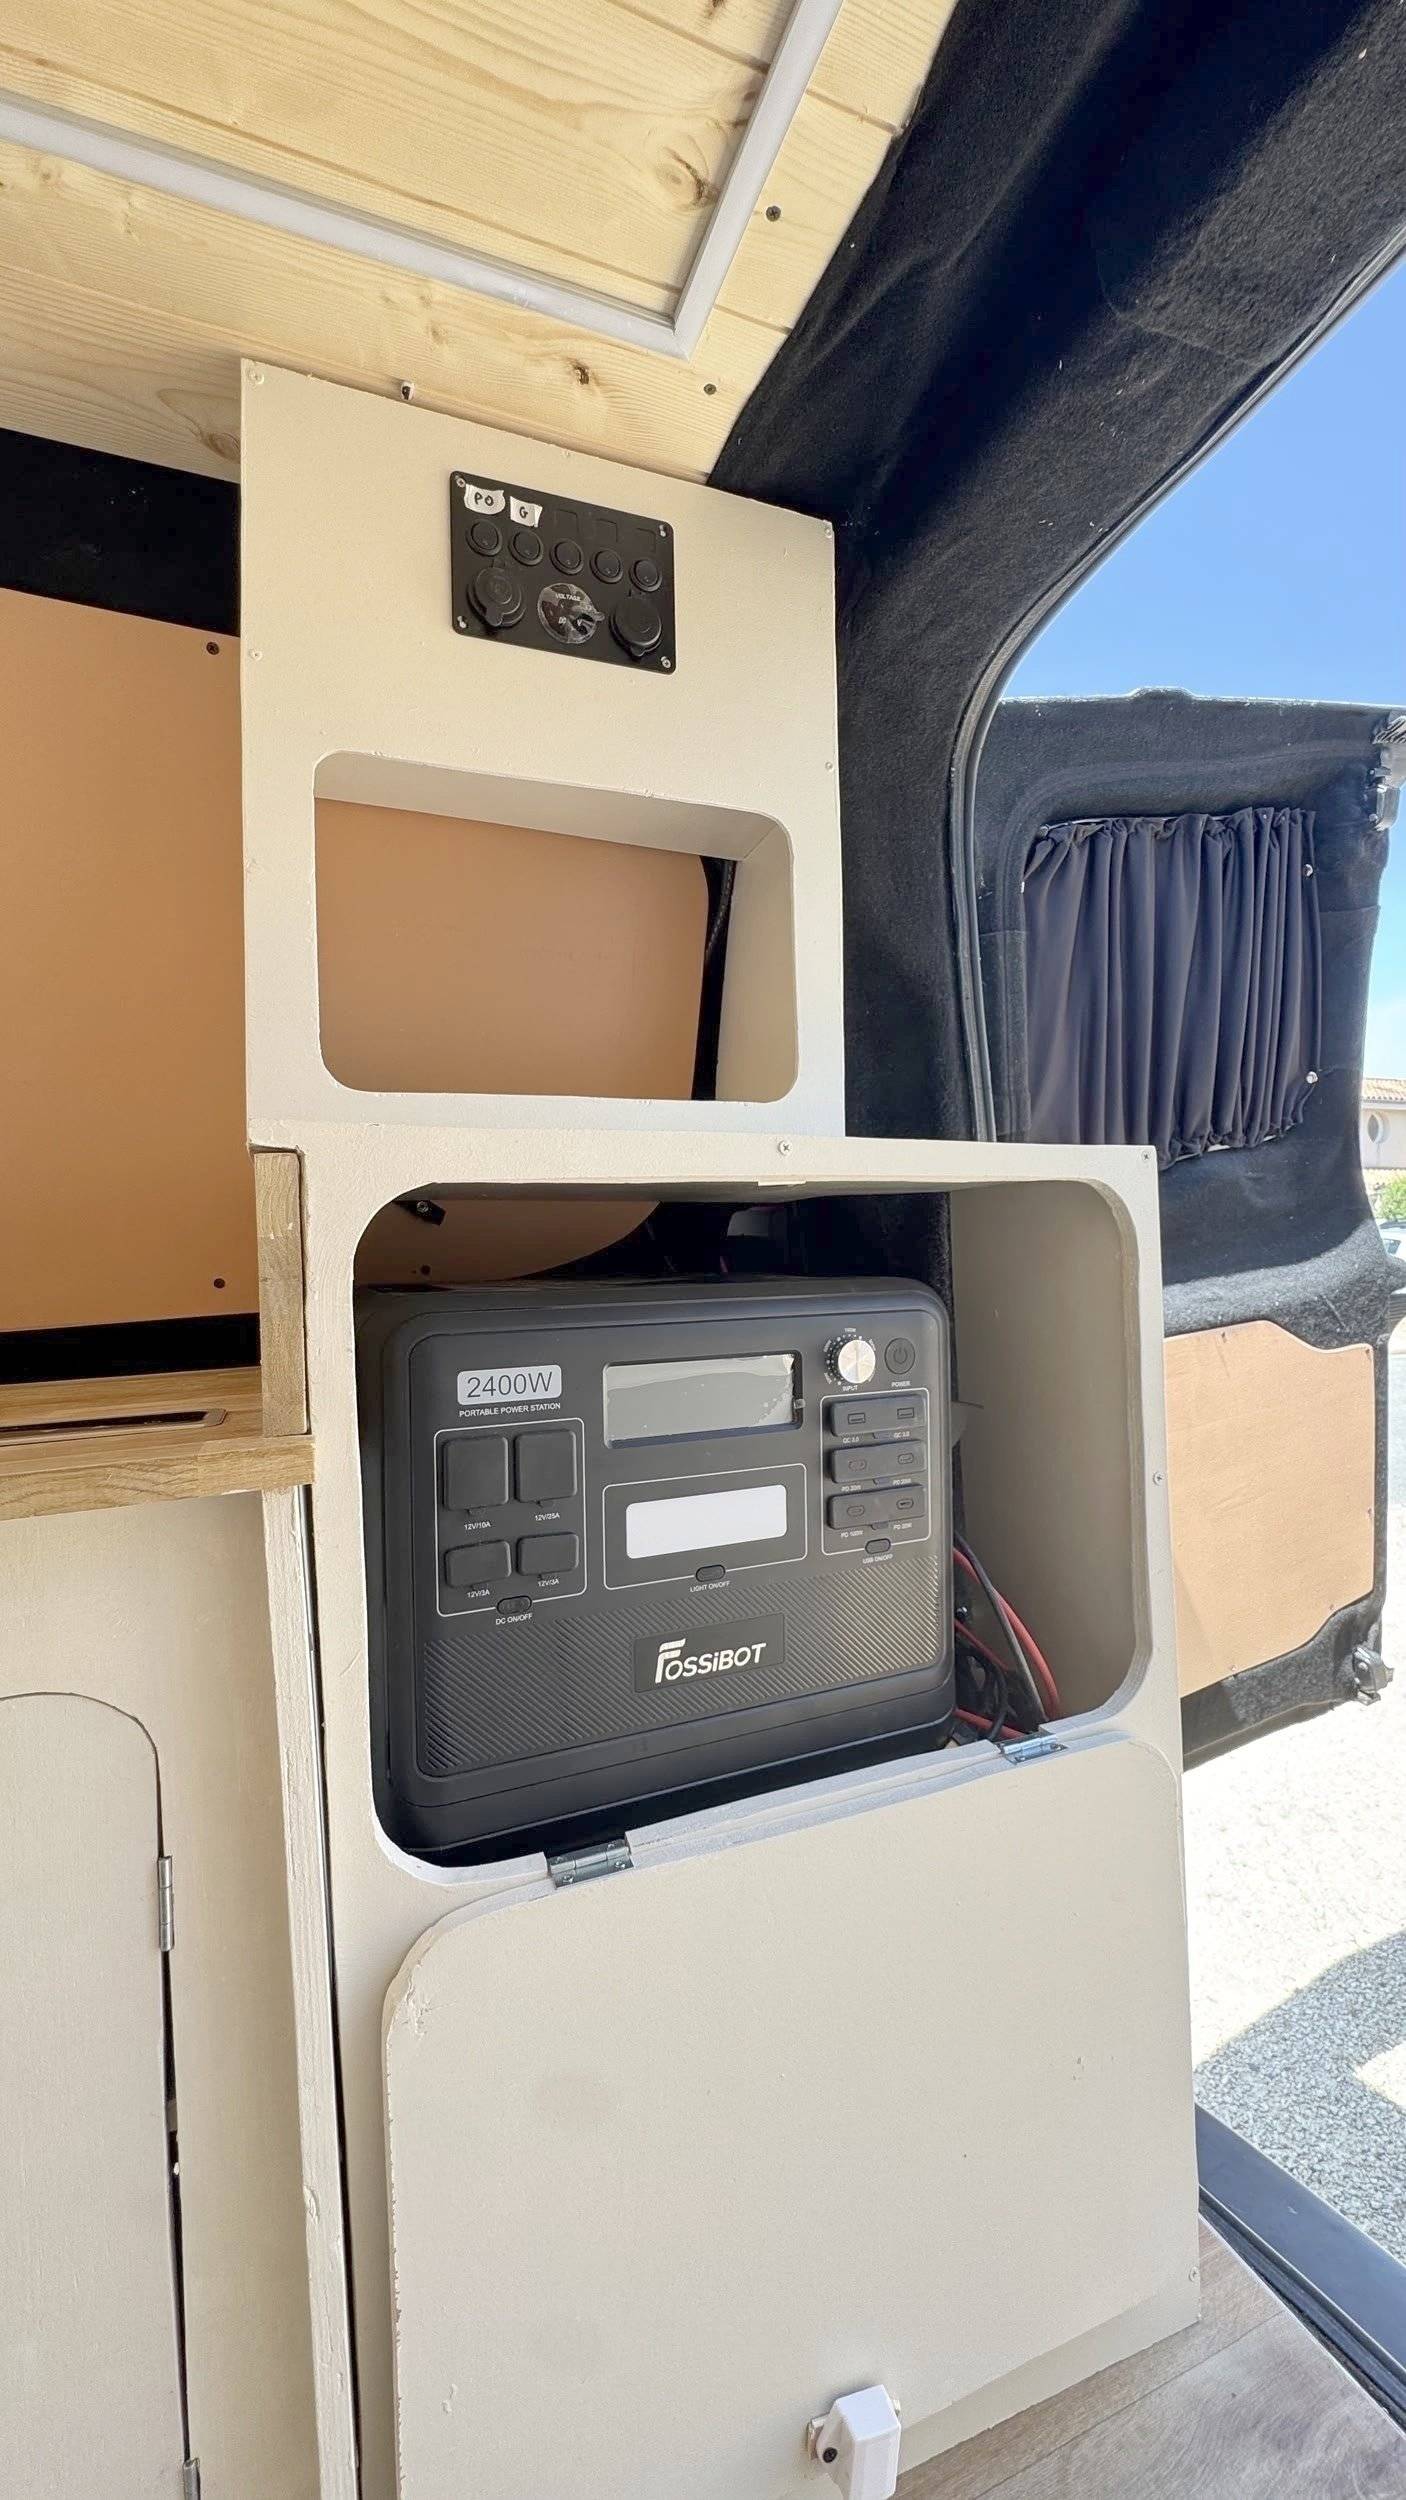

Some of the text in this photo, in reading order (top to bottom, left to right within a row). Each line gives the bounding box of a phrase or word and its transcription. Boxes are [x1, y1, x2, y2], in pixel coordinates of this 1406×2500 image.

[474, 491, 494, 506] PO
[519, 506, 528, 518] G
[555, 592, 581, 601] VOLTAGE
[467, 1371, 552, 1398] 2400W
[459, 1402, 561, 1418] PORTABLE POWER STATION
[463, 1521, 492, 1530] 12V/10A
[689, 1580, 730, 1592] LIGHT ON/OFF
[506, 1612, 533, 1623] ON/OFF
